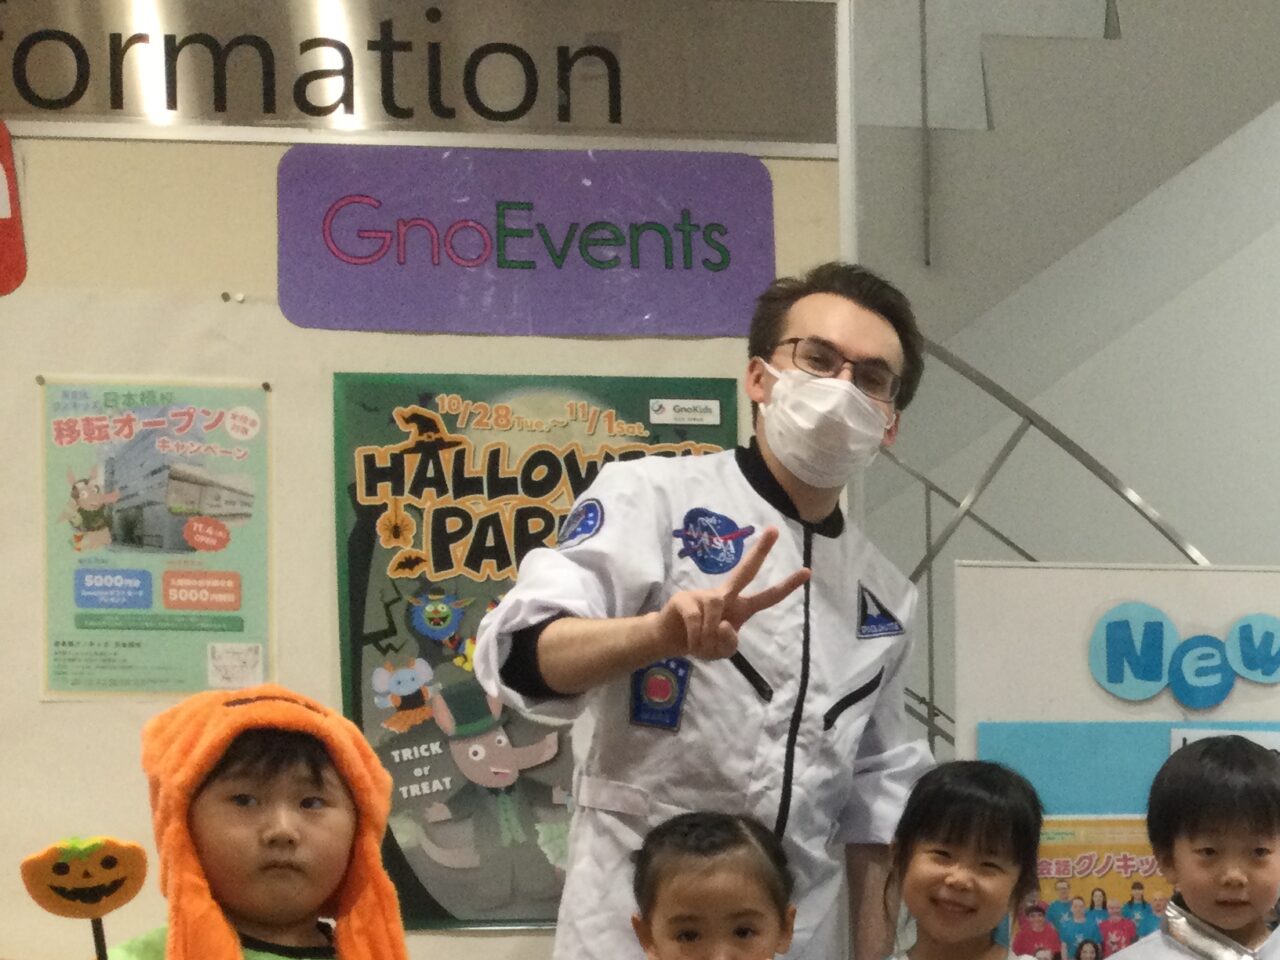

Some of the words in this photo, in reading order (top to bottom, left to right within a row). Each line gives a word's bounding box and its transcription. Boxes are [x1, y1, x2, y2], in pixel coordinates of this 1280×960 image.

[0, 7, 622, 125] ormation
[321, 193, 732, 272] GnoEvents
[53, 406, 226, 446] 移転オープン
[362, 445, 718, 503] HALLOW
[430, 505, 569, 573] PAR
[390, 740, 444, 763] TRICK
[413, 765, 431, 777] or
[399, 776, 452, 800] TREAT
[1037, 851, 1164, 878] 会話グノキッ
